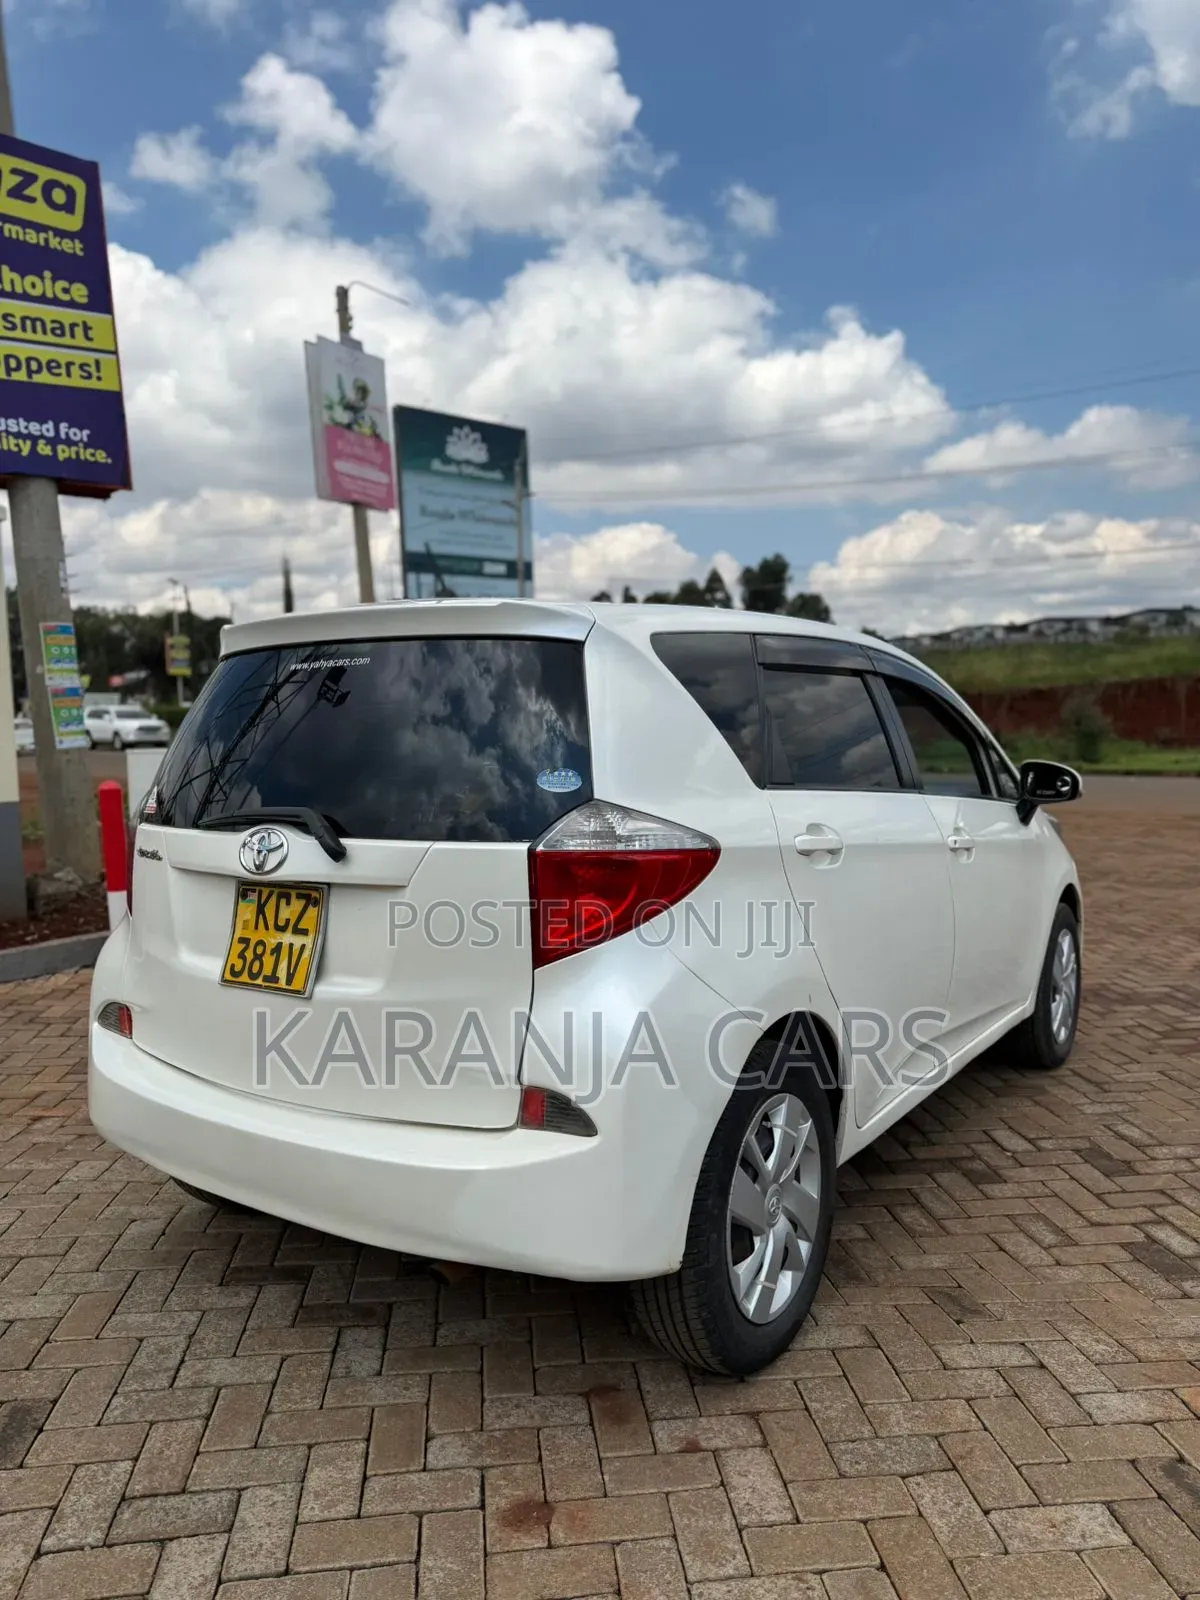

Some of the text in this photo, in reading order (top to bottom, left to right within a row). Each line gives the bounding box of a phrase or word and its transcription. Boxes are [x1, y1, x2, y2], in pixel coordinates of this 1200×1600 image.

[0, 167, 77, 216] za
[0, 221, 84, 257] market
[0, 264, 89, 304] hoice
[1, 312, 94, 342] smart
[0, 353, 103, 382] ppers!
[0, 432, 112, 464] ity & price.
[59, 422, 91, 442] for
[289, 657, 371, 672] www.yahyacars.com
[254, 888, 313, 937] KCZ
[229, 936, 306, 987] 381V
